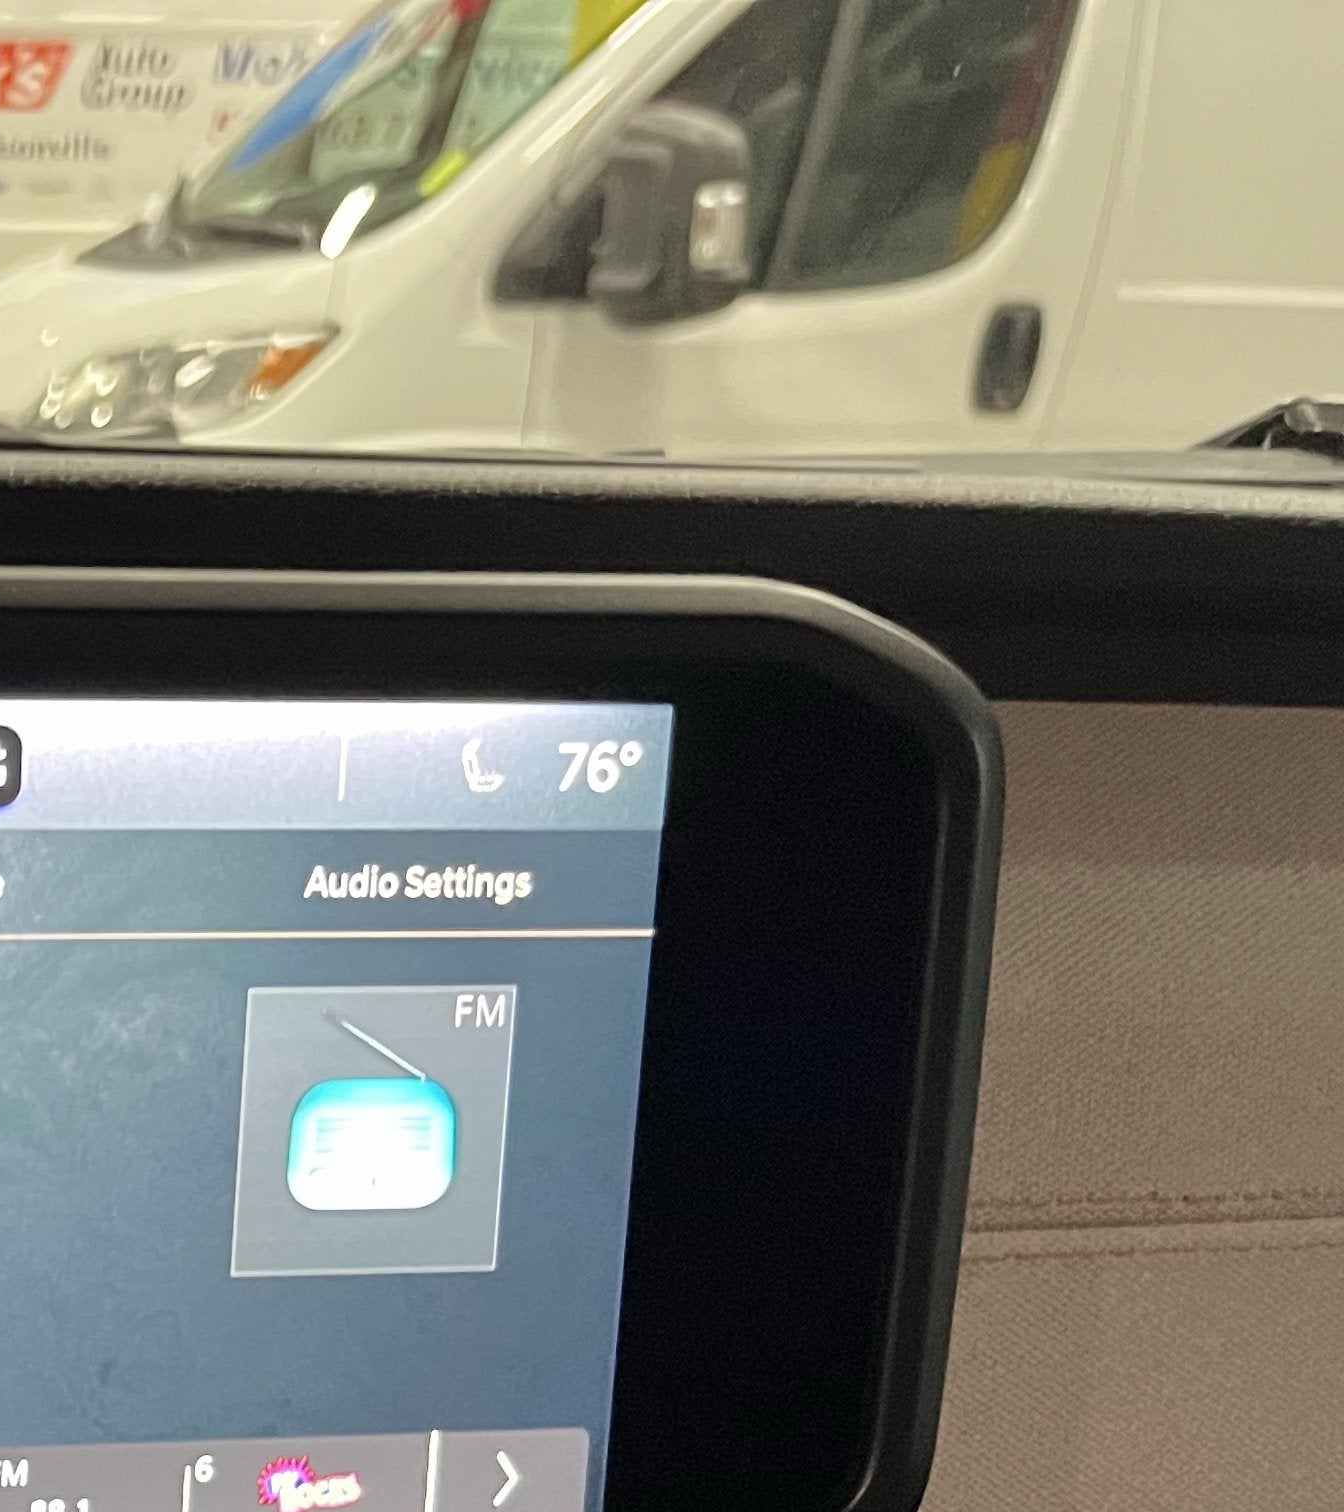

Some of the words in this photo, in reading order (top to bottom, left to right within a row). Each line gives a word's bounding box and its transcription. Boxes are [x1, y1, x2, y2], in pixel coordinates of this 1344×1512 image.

[559, 740, 644, 793] 76°
[303, 865, 399, 900] Audio
[404, 864, 532, 905] Settings
[454, 994, 505, 1028] FM
[194, 1454, 214, 1483] 6
